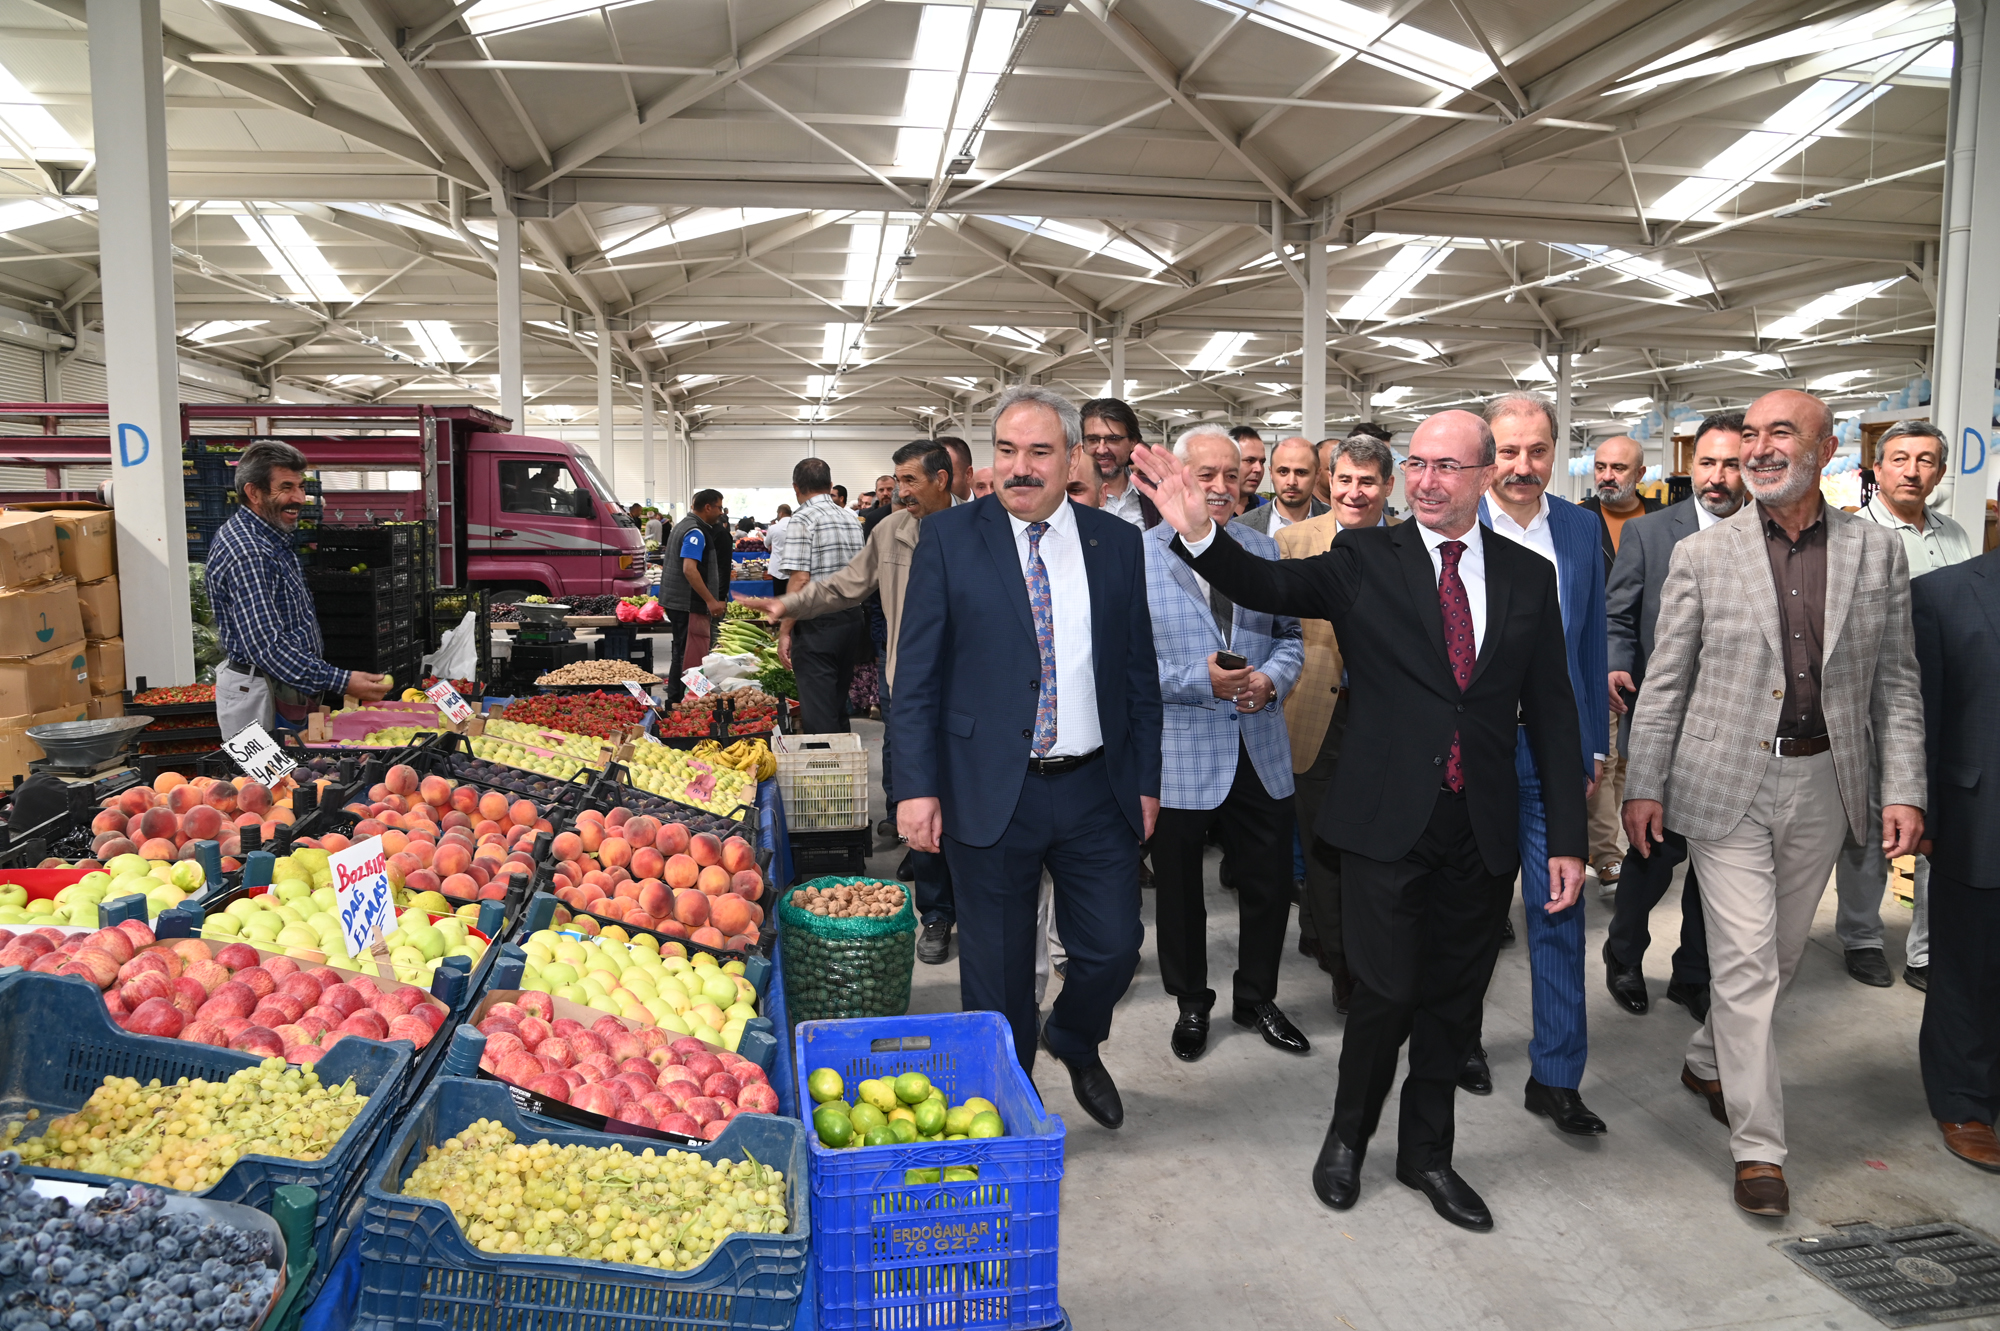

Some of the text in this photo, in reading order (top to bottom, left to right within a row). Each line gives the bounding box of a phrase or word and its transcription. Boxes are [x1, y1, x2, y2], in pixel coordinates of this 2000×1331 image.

[117, 423, 150, 467] D
[1961, 426, 1986, 475] D
[646, 498, 652, 507] B
[426, 684, 451, 703] BALLI
[336, 852, 387, 893] BOZKIR
[353, 874, 388, 953] ELMASI
[892, 1221, 990, 1243] ERDOĞANLAR
[903, 1236, 980, 1254] 76 GZP
